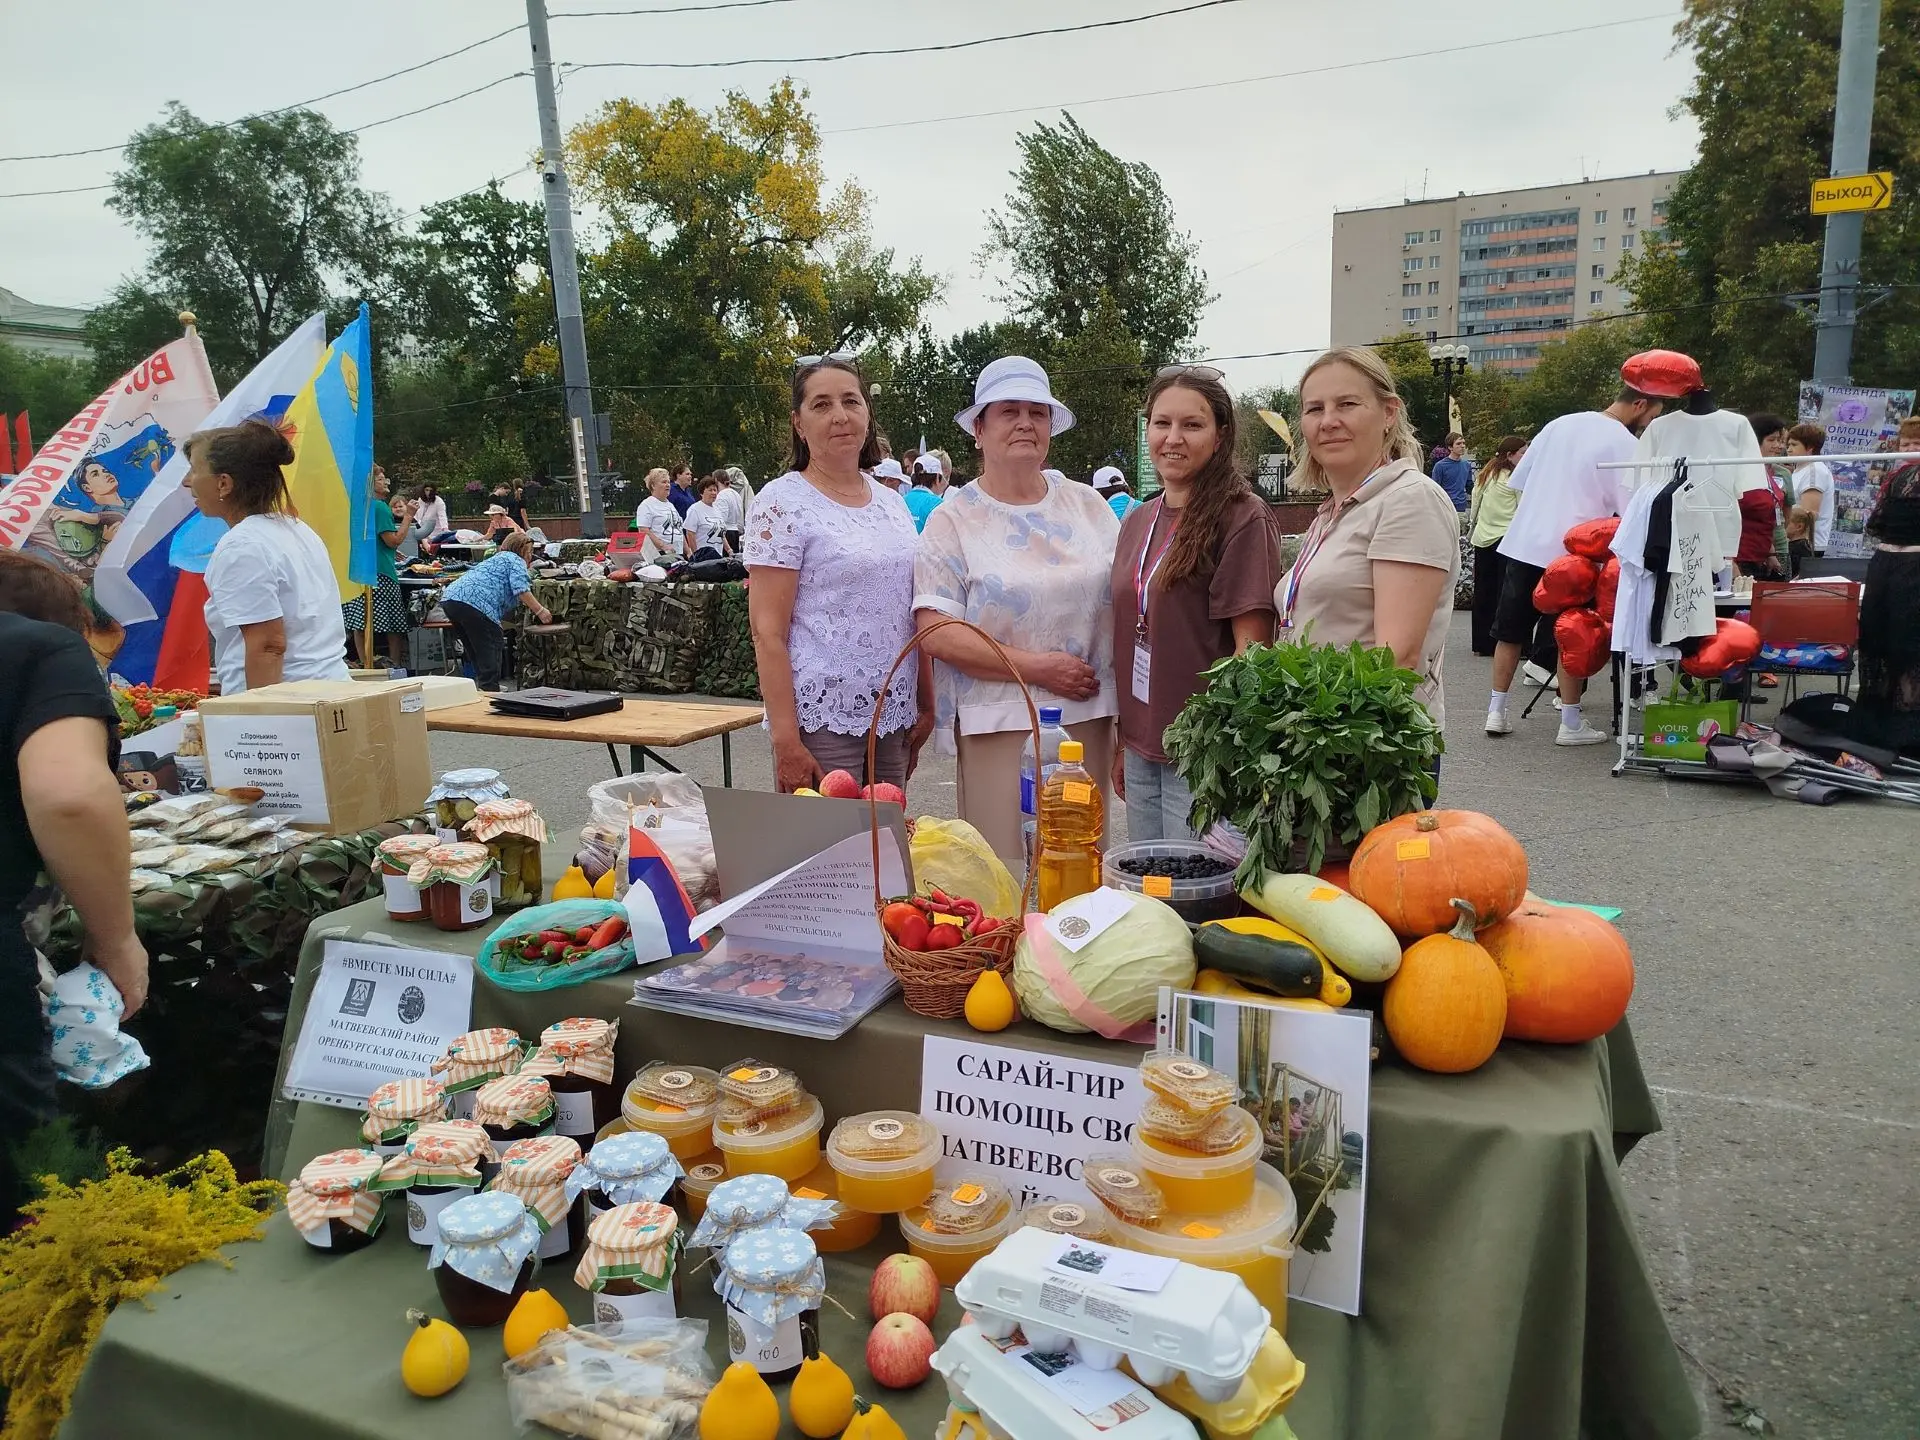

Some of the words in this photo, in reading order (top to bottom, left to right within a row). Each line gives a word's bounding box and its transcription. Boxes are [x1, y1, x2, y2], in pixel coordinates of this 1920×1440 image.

[1815, 186, 1873, 202] ВЫХОД
[1657, 724, 1689, 733] YOUR
[224, 749, 251, 761] «Супы
[257, 749, 289, 762] фронту
[290, 752, 301, 760] от
[243, 767, 283, 776] селянок»
[280, 791, 299, 799] район
[278, 801, 303, 809] область
[840, 881, 860, 889] СВО
[342, 957, 393, 975] #ВМЕСТЕ
[394, 964, 416, 978] МЫ
[417, 967, 457, 984] СИЛА#
[328, 1019, 404, 1040] МАТВЕЕВСКИЙ
[403, 1031, 441, 1046] РАЙОН
[318, 1035, 394, 1057] ОРЕНБУРГСКАЯ
[956, 1053, 1125, 1100] САРАЙ-ГИР
[934, 1089, 1075, 1137] ПОМОЩЬ
[758, 1346, 780, 1361] 100
